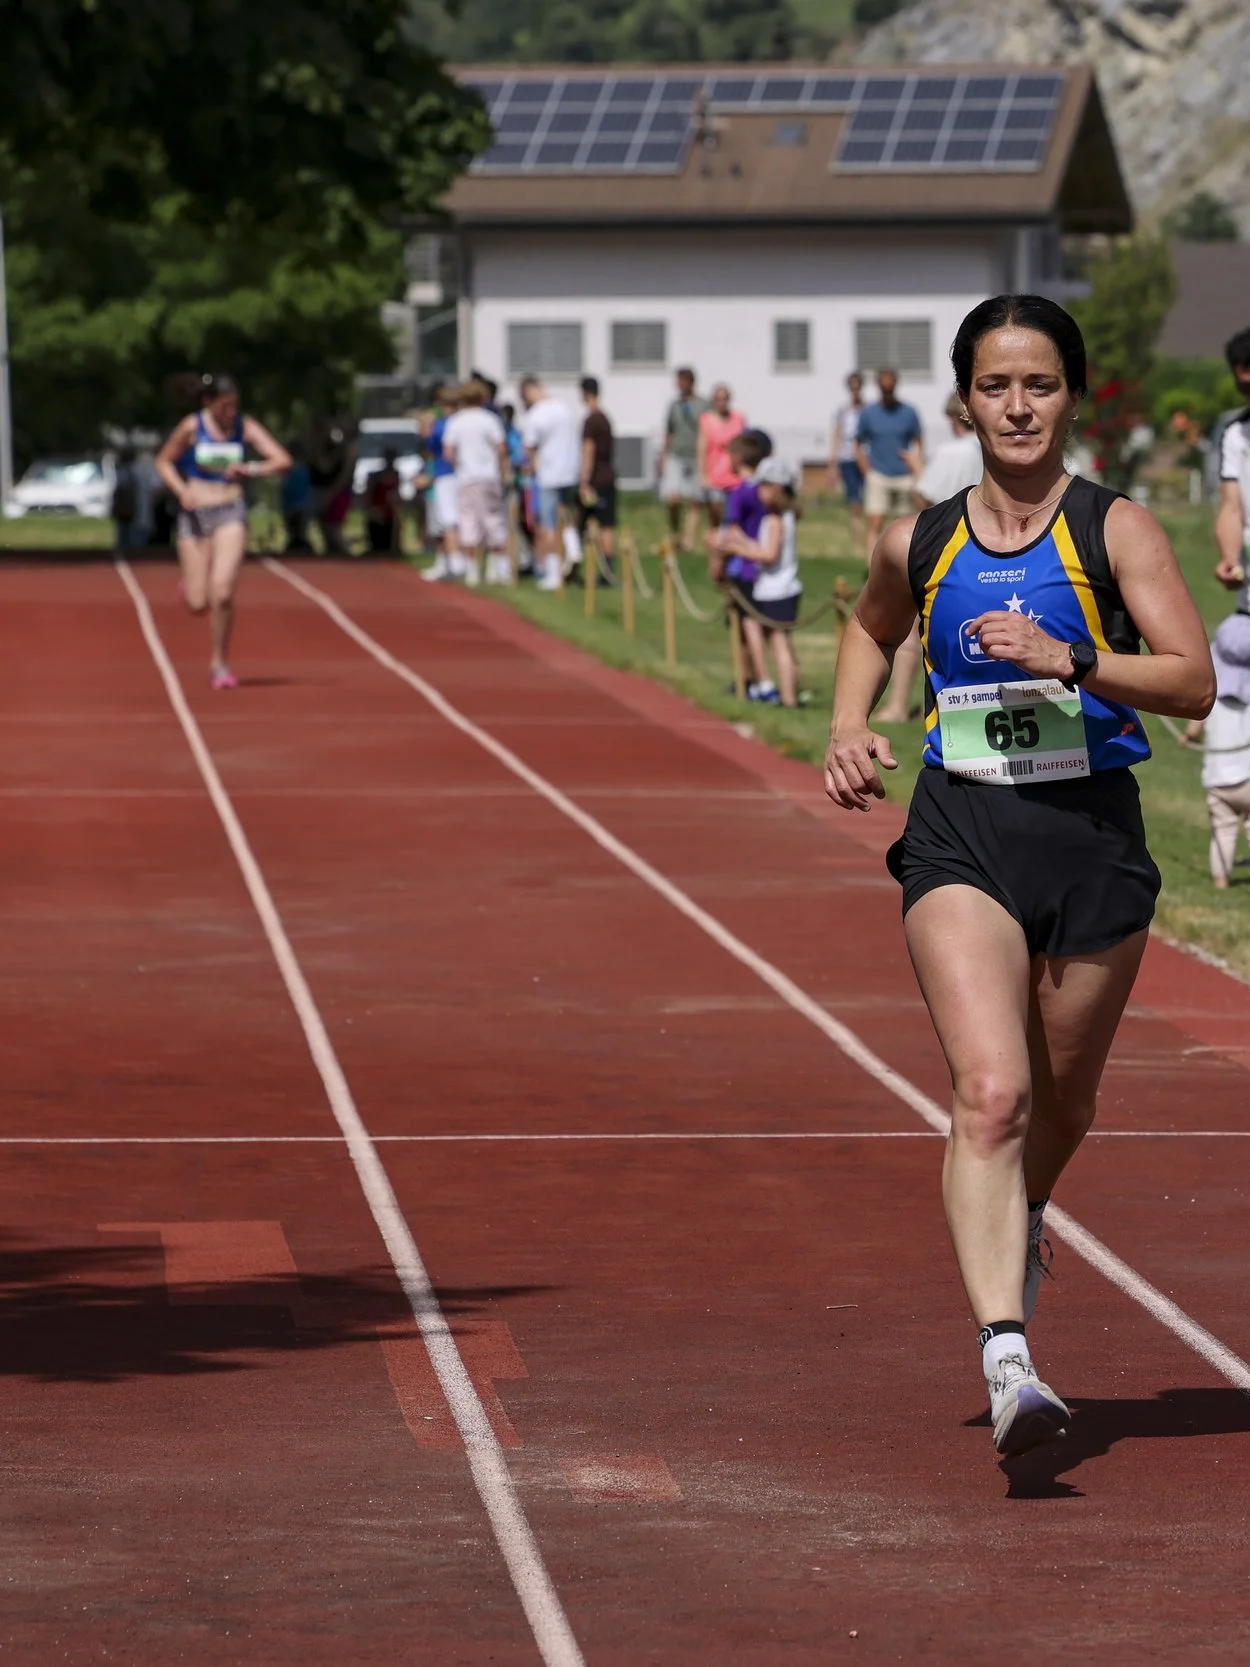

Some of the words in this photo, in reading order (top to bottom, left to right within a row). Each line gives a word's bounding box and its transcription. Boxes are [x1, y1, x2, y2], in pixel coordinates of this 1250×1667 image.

[977, 567, 1027, 581] panzeri
[948, 693, 961, 705] stv
[971, 689, 1003, 704] gampel
[984, 708, 1040, 752] 65
[1036, 758, 1085, 772] RAIFFEISEN
